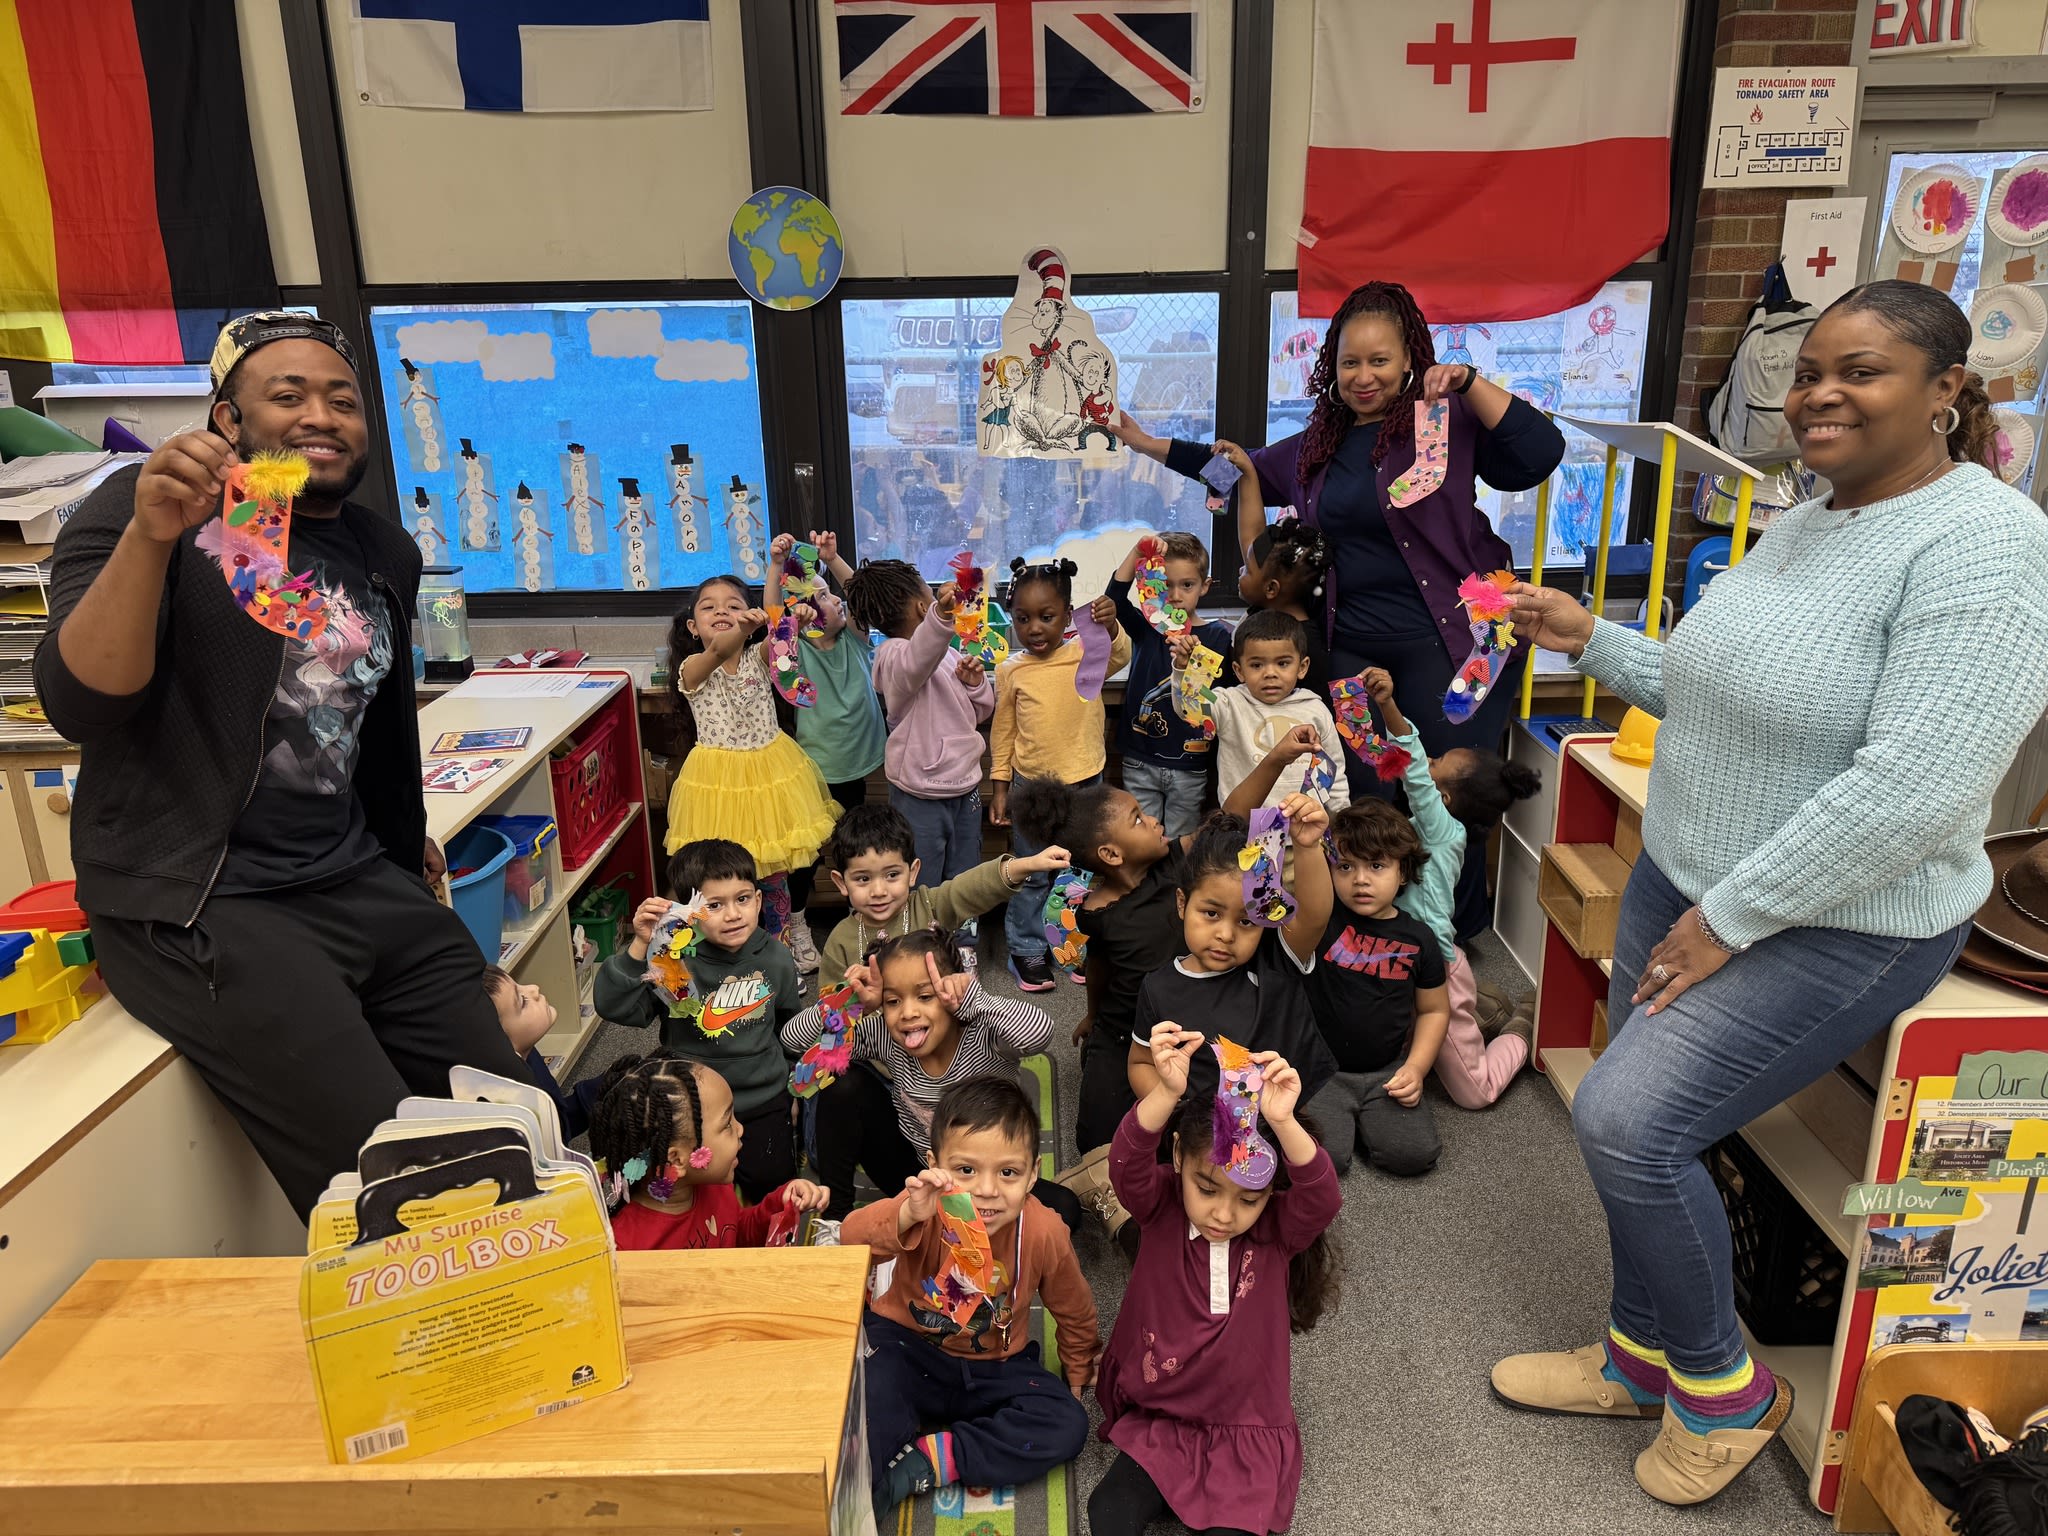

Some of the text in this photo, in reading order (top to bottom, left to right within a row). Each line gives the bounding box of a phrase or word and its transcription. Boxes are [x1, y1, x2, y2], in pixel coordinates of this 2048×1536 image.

[1736, 89, 1829, 99] TORNADO SAFETY AREA
[1738, 78, 1836, 88] FIRE EVACUATION ROUTE
[1810, 210, 1843, 220] First Aid
[1976, 350, 1994, 362] Liam
[1323, 925, 1420, 980] NIKE
[711, 979, 763, 1009] NIKE
[1978, 1063, 2030, 1099] Our
[2008, 1111, 2041, 1119] geographic
[1859, 1187, 1938, 1212] Willow
[384, 1207, 523, 1257] My Surprise
[345, 1218, 569, 1307] TOOLBOX
[1909, 1272, 1941, 1283] LIBRARY
[1933, 1243, 2048, 1301] Joliet
[409, 1329, 418, 1337] by
[451, 1315, 468, 1323] their
[469, 1309, 487, 1319] many
[418, 1316, 438, 1325] Young
[440, 1307, 466, 1318] children
[480, 1292, 514, 1307] fascinated
[429, 1329, 445, 1338] have
[446, 1321, 471, 1333] endless
[472, 1316, 491, 1326] hours
[500, 1302, 534, 1317] interactive
[437, 1330, 470, 1345] searching
[481, 1317, 507, 1332] gadgets
[508, 1314, 521, 1322] and
[521, 1307, 544, 1319] gizmos
[418, 1348, 441, 1357] hidden
[442, 1341, 461, 1351] under
[462, 1335, 479, 1346] every
[481, 1326, 508, 1339] amazing
[448, 1351, 459, 1359] THE
[460, 1345, 477, 1354] HOME
